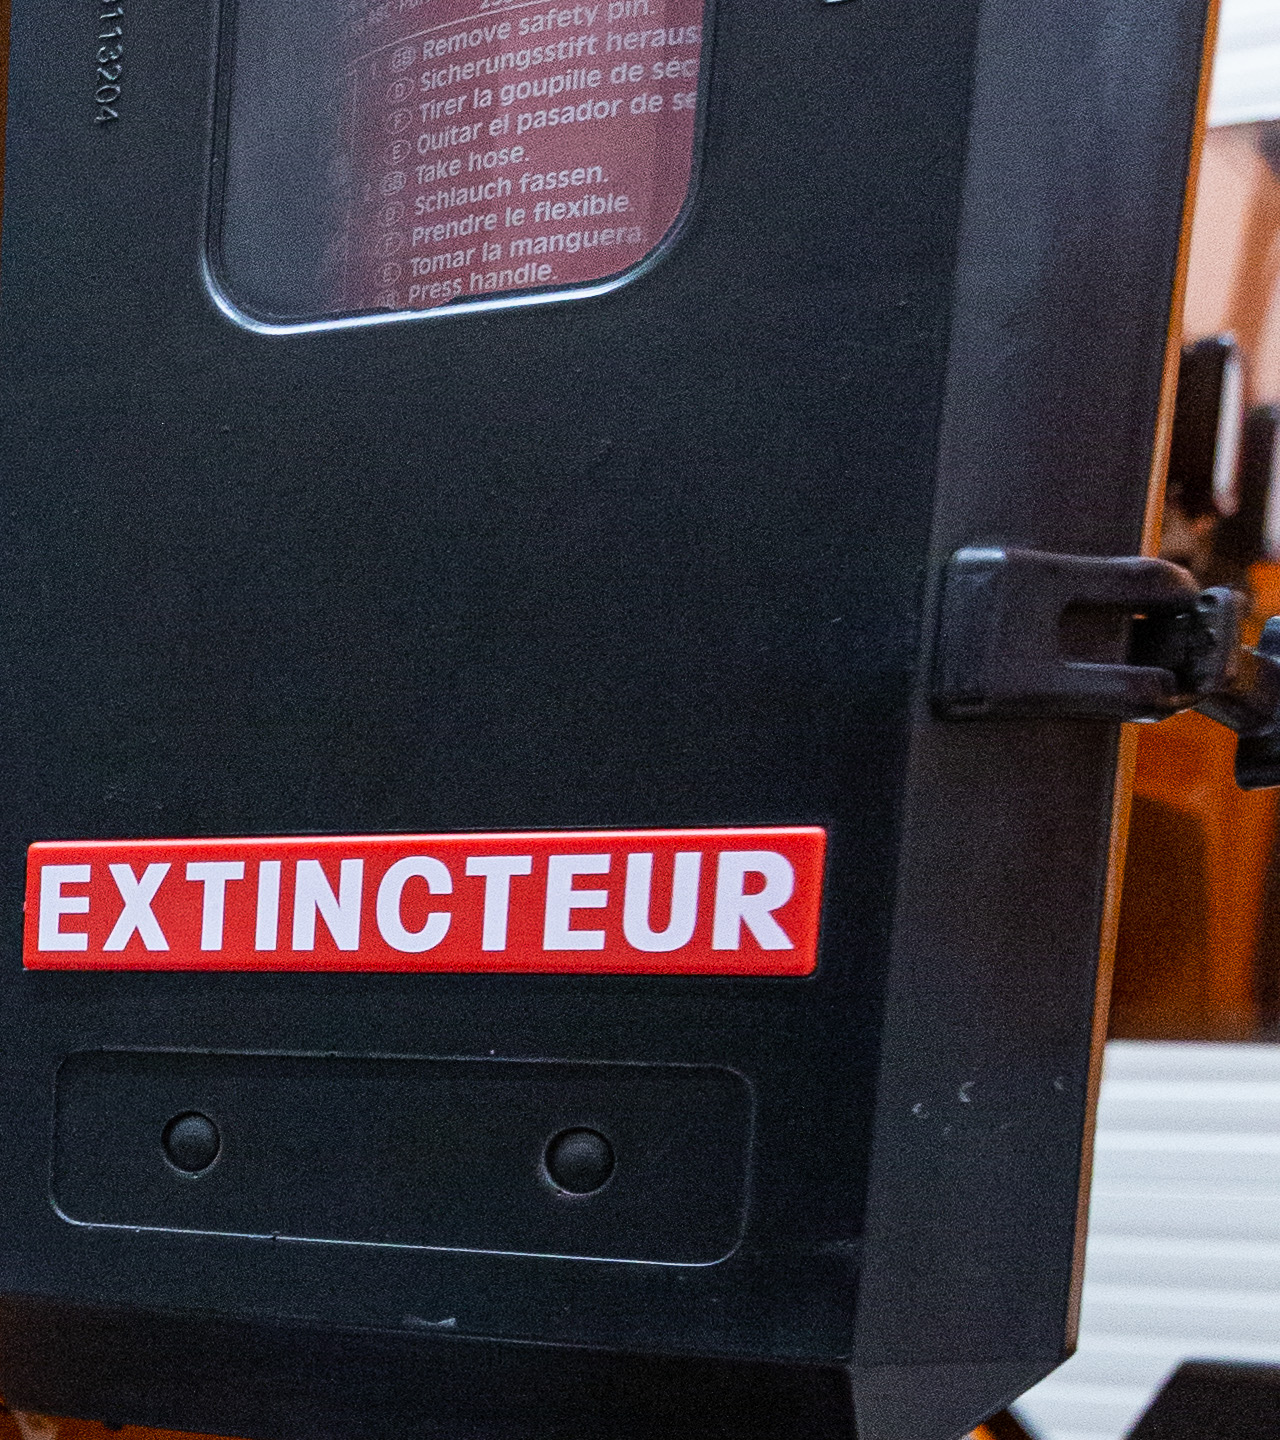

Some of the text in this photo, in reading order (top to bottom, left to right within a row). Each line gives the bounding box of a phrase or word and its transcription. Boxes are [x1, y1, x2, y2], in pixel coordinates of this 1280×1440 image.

[422, 20, 512, 62] Remove
[518, 1, 598, 34] safety
[418, 30, 598, 92] Sicherungsstift
[419, 92, 468, 124] Tirer
[473, 87, 493, 111] la
[500, 59, 604, 106] goupille
[610, 57, 644, 84] de
[416, 121, 481, 156] Quitar
[488, 114, 510, 138] el
[515, 96, 623, 133] pasador
[630, 90, 664, 115] de
[413, 176, 512, 217] Schlauch
[519, 163, 609, 194] fassen.
[414, 156, 461, 188] Take
[467, 144, 530, 176] hose.
[411, 210, 498, 248] Prendre
[504, 204, 525, 228] le
[408, 245, 485, 280] Tomar
[482, 239, 502, 262] la
[408, 274, 463, 306] Press
[469, 260, 558, 293] handle.
[38, 850, 796, 953] EXTINCTEUR
